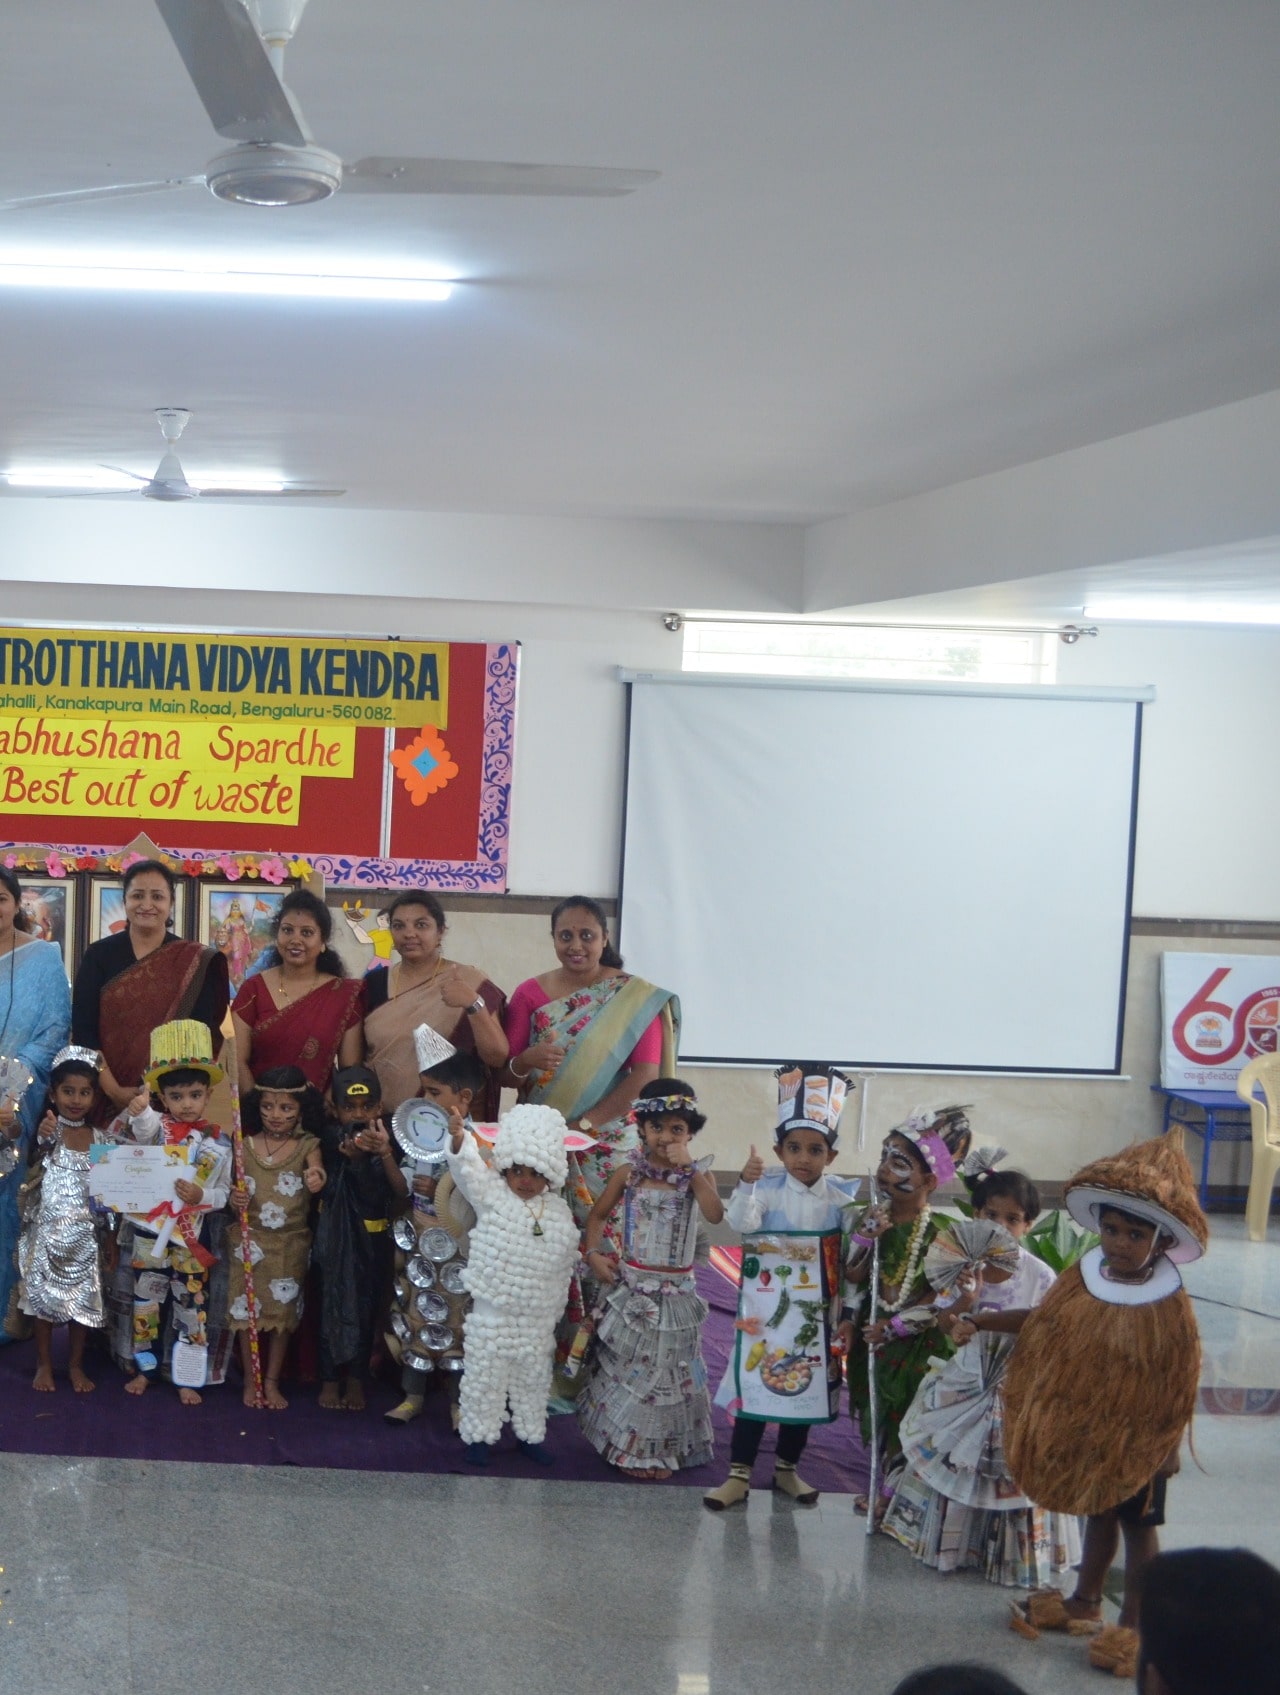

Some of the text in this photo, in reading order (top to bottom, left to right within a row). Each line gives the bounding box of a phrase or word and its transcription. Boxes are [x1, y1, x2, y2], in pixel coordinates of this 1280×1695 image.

[195, 643, 292, 695] VIDYA
[299, 648, 440, 701] KENDRA
[45, 694, 143, 714] Kanakapura
[149, 698, 186, 714] Main
[190, 699, 237, 719] Road,
[208, 725, 342, 773] Spardhe
[0, 766, 295, 815] Best out of waste
